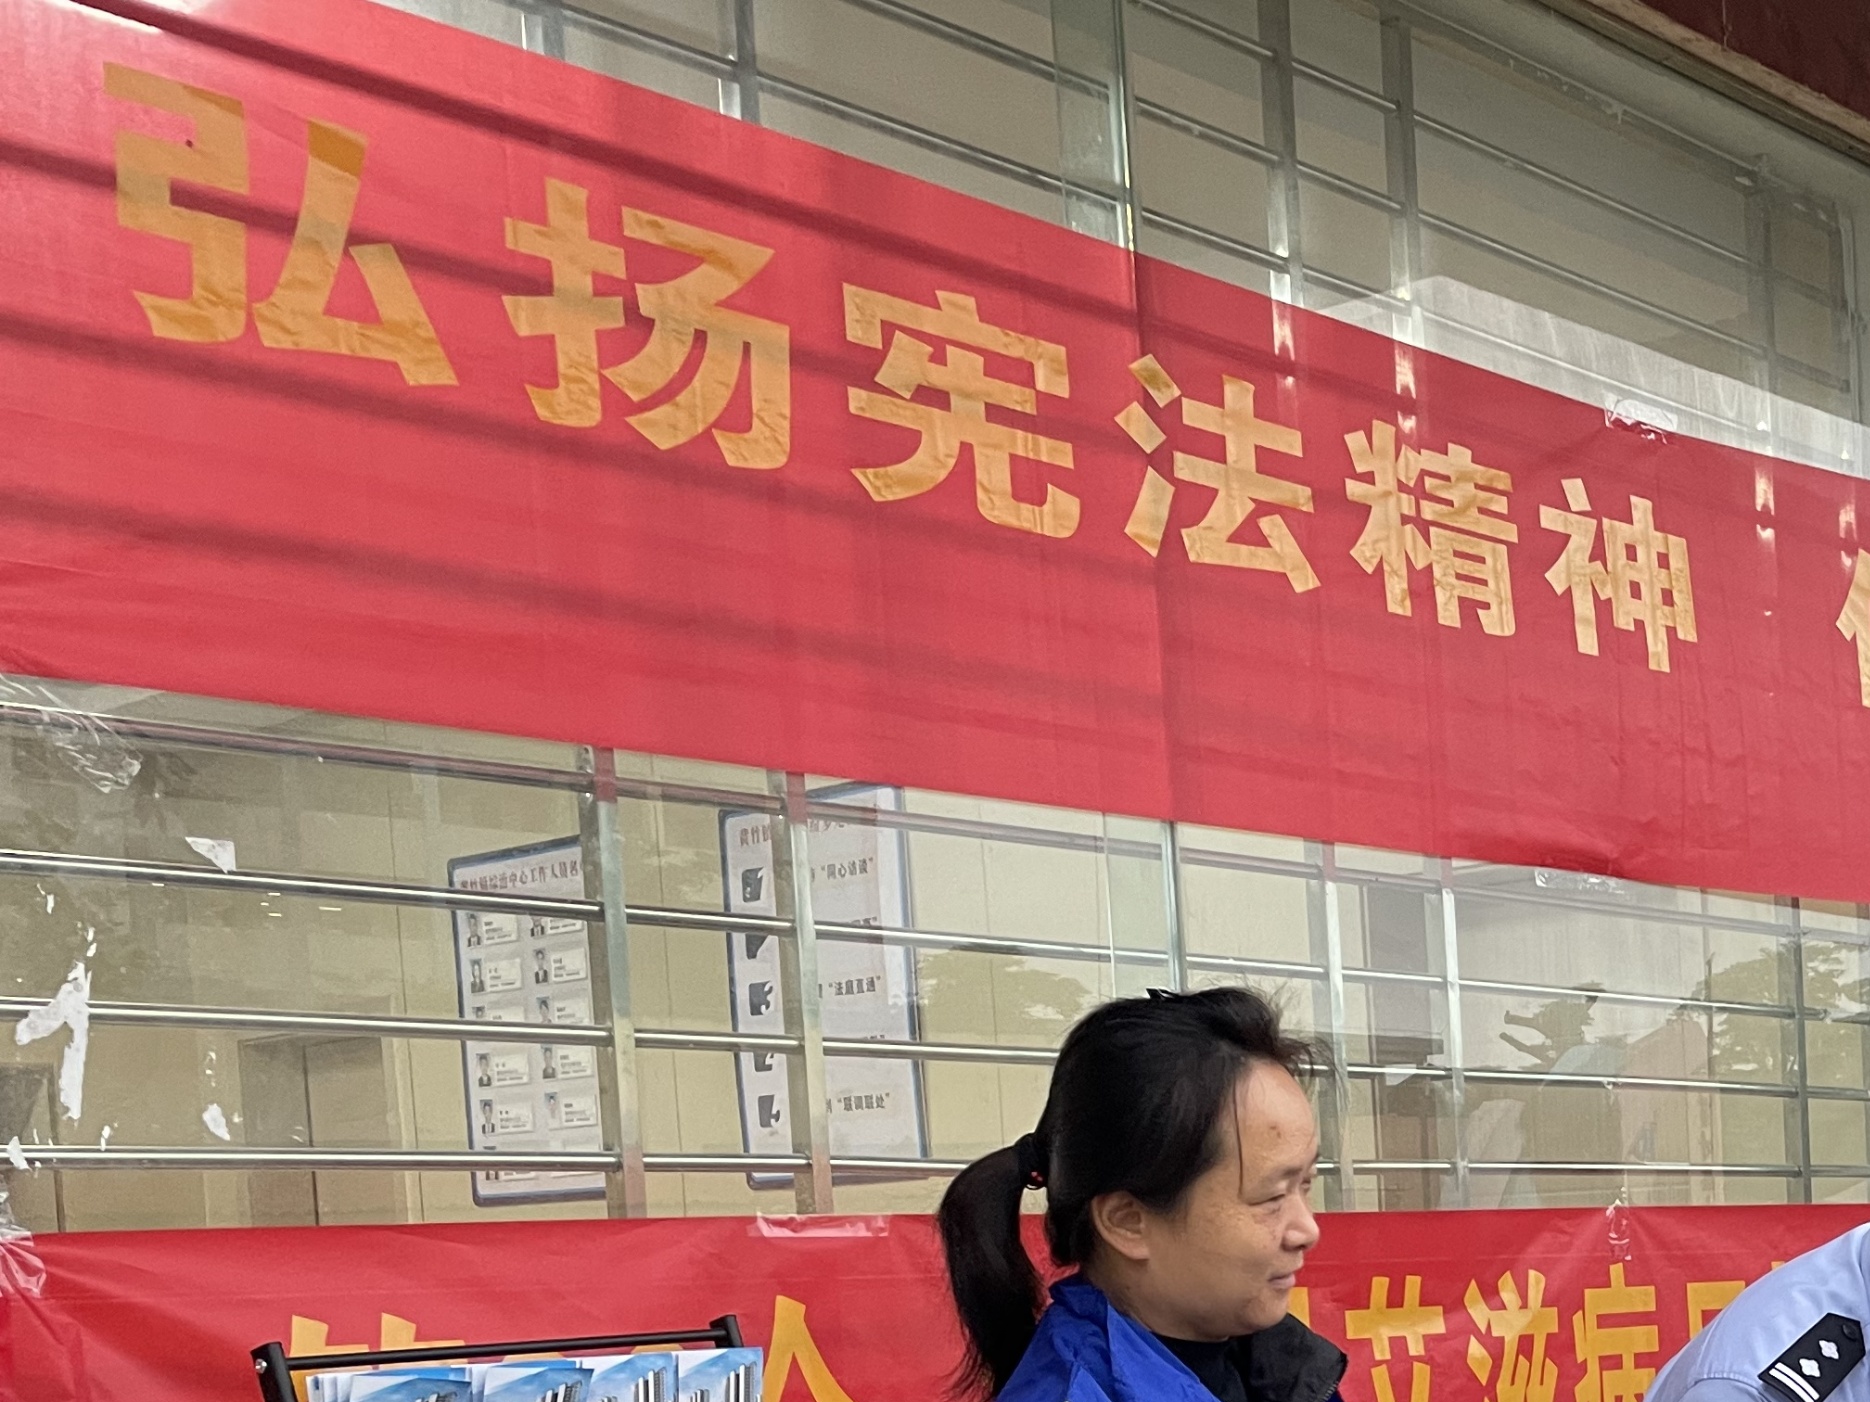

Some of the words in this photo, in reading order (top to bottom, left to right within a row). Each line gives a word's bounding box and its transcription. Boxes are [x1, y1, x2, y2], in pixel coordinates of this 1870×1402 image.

[103, 62, 1697, 673] 弘扬宪法精神
